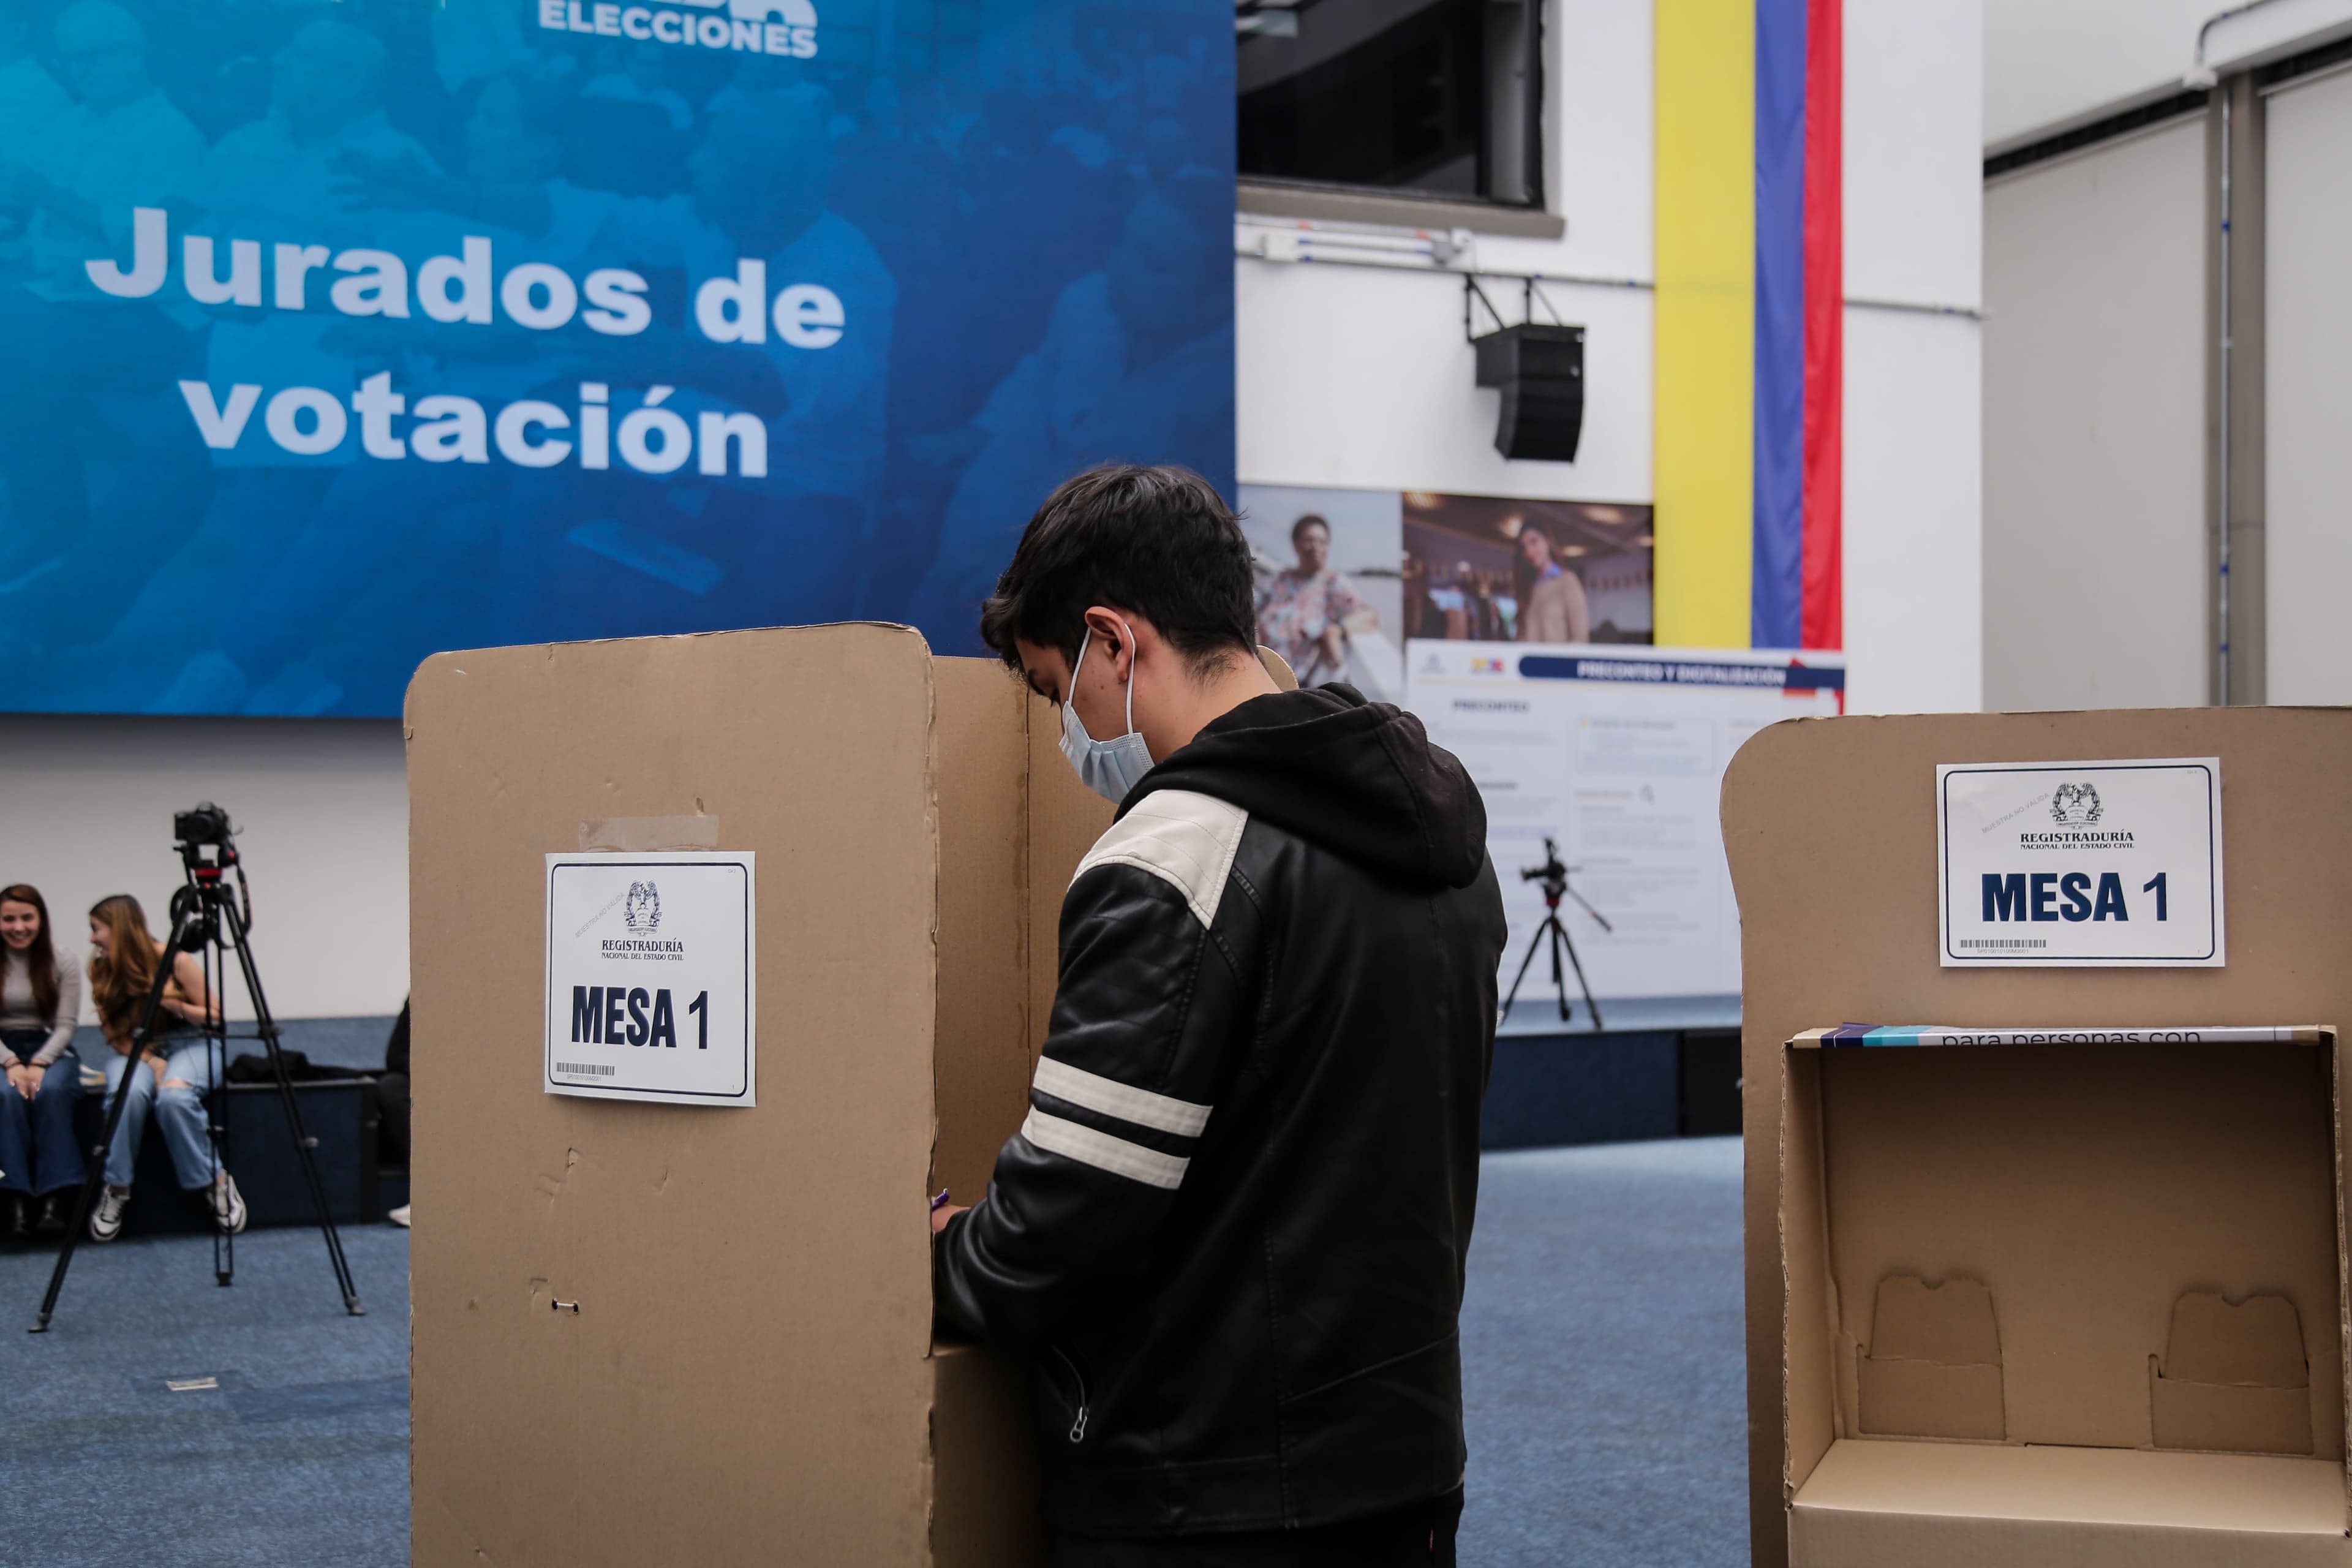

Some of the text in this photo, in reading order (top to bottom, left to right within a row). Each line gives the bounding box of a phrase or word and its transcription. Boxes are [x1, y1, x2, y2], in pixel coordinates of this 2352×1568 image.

[539, 0, 818, 59] ELECCIONES
[85, 206, 846, 349] Jurados de
[178, 371, 768, 478] votación
[1577, 660, 1664, 682] PRECONTEO
[1665, 663, 1676, 682] Y
[2021, 829, 2135, 842] REGISTRADURÍA
[1981, 872, 2167, 921] MESA 1
[602, 937, 684, 952] REGISTRADURÍA
[571, 986, 709, 1050] MESA 1
[2149, 1031, 2200, 1042] con
